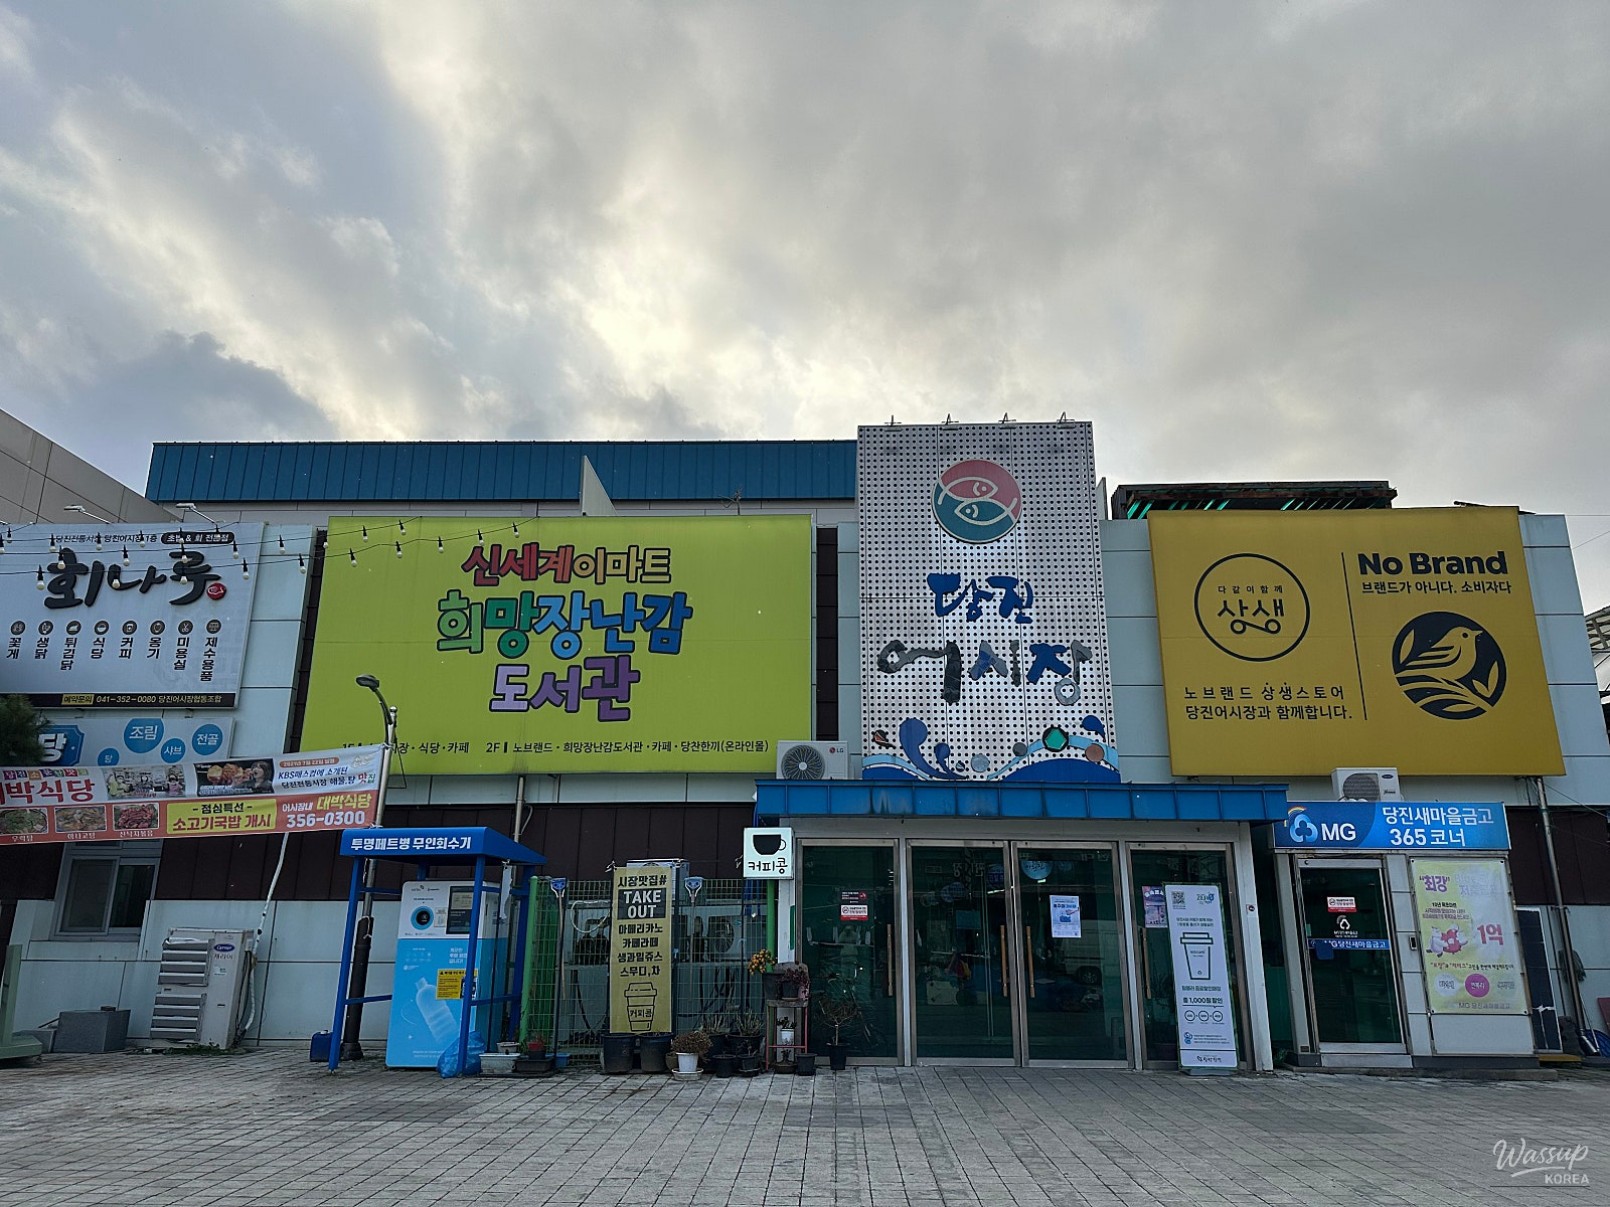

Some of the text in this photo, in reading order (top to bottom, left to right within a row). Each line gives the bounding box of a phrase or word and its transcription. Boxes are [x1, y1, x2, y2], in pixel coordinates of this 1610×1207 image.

[461, 542, 672, 586] 신세계이마트
[1358, 550, 1509, 576] No Brand
[1361, 580, 1512, 595] 브랜드가 아니다. 소비자다
[926, 572, 1035, 624] 당진
[437, 588, 694, 660] 희망장난감
[6, 637, 22, 660] 꽃게
[34, 637, 50, 660] 생닭
[60, 636, 78, 671] 튀김닭
[90, 637, 106, 660] 식당
[118, 637, 134, 660] 커피
[146, 637, 163, 660] 옹기
[173, 636, 190, 671] 미용실
[200, 636, 219, 682] 제수용품
[877, 639, 1093, 706] 어시장
[489, 655, 640, 722] 도서관
[1184, 685, 1254, 701] 노브랜드
[1185, 703, 1353, 721] 당진어시장과 함께합니다.
[129, 725, 158, 741] 조림
[196, 733, 220, 746] 전골
[163, 746, 182, 756] 샤브
[418, 742, 441, 754] 식당
[447, 741, 470, 754] 카페
[486, 742, 501, 753] 2F
[513, 741, 554, 754] 노브랜드
[563, 741, 644, 754] 희망장난감도서관
[651, 741, 673, 753] 카페
[0, 778, 95, 806] 박식당
[201, 801, 245, 815] 점심특선
[316, 793, 372, 811] 대박식당
[172, 813, 272, 831] 소고기국밥 개시
[286, 810, 365, 829] 356-0300
[1382, 807, 1495, 826] 당진새마을금고
[1321, 823, 1357, 841] MG
[1389, 828, 1467, 847] 365 코너
[351, 836, 472, 850] 투명페트병 무인회수기
[747, 856, 788, 875] 커피콩
[617, 874, 668, 888] 시장맛집#
[623, 889, 662, 904] TAKE
[627, 903, 658, 919] OUT
[618, 922, 663, 935] 아메리카노
[1477, 923, 1504, 946] 1억
[622, 936, 659, 949] 카페라떼
[617, 950, 663, 963] 생과일쥬스
